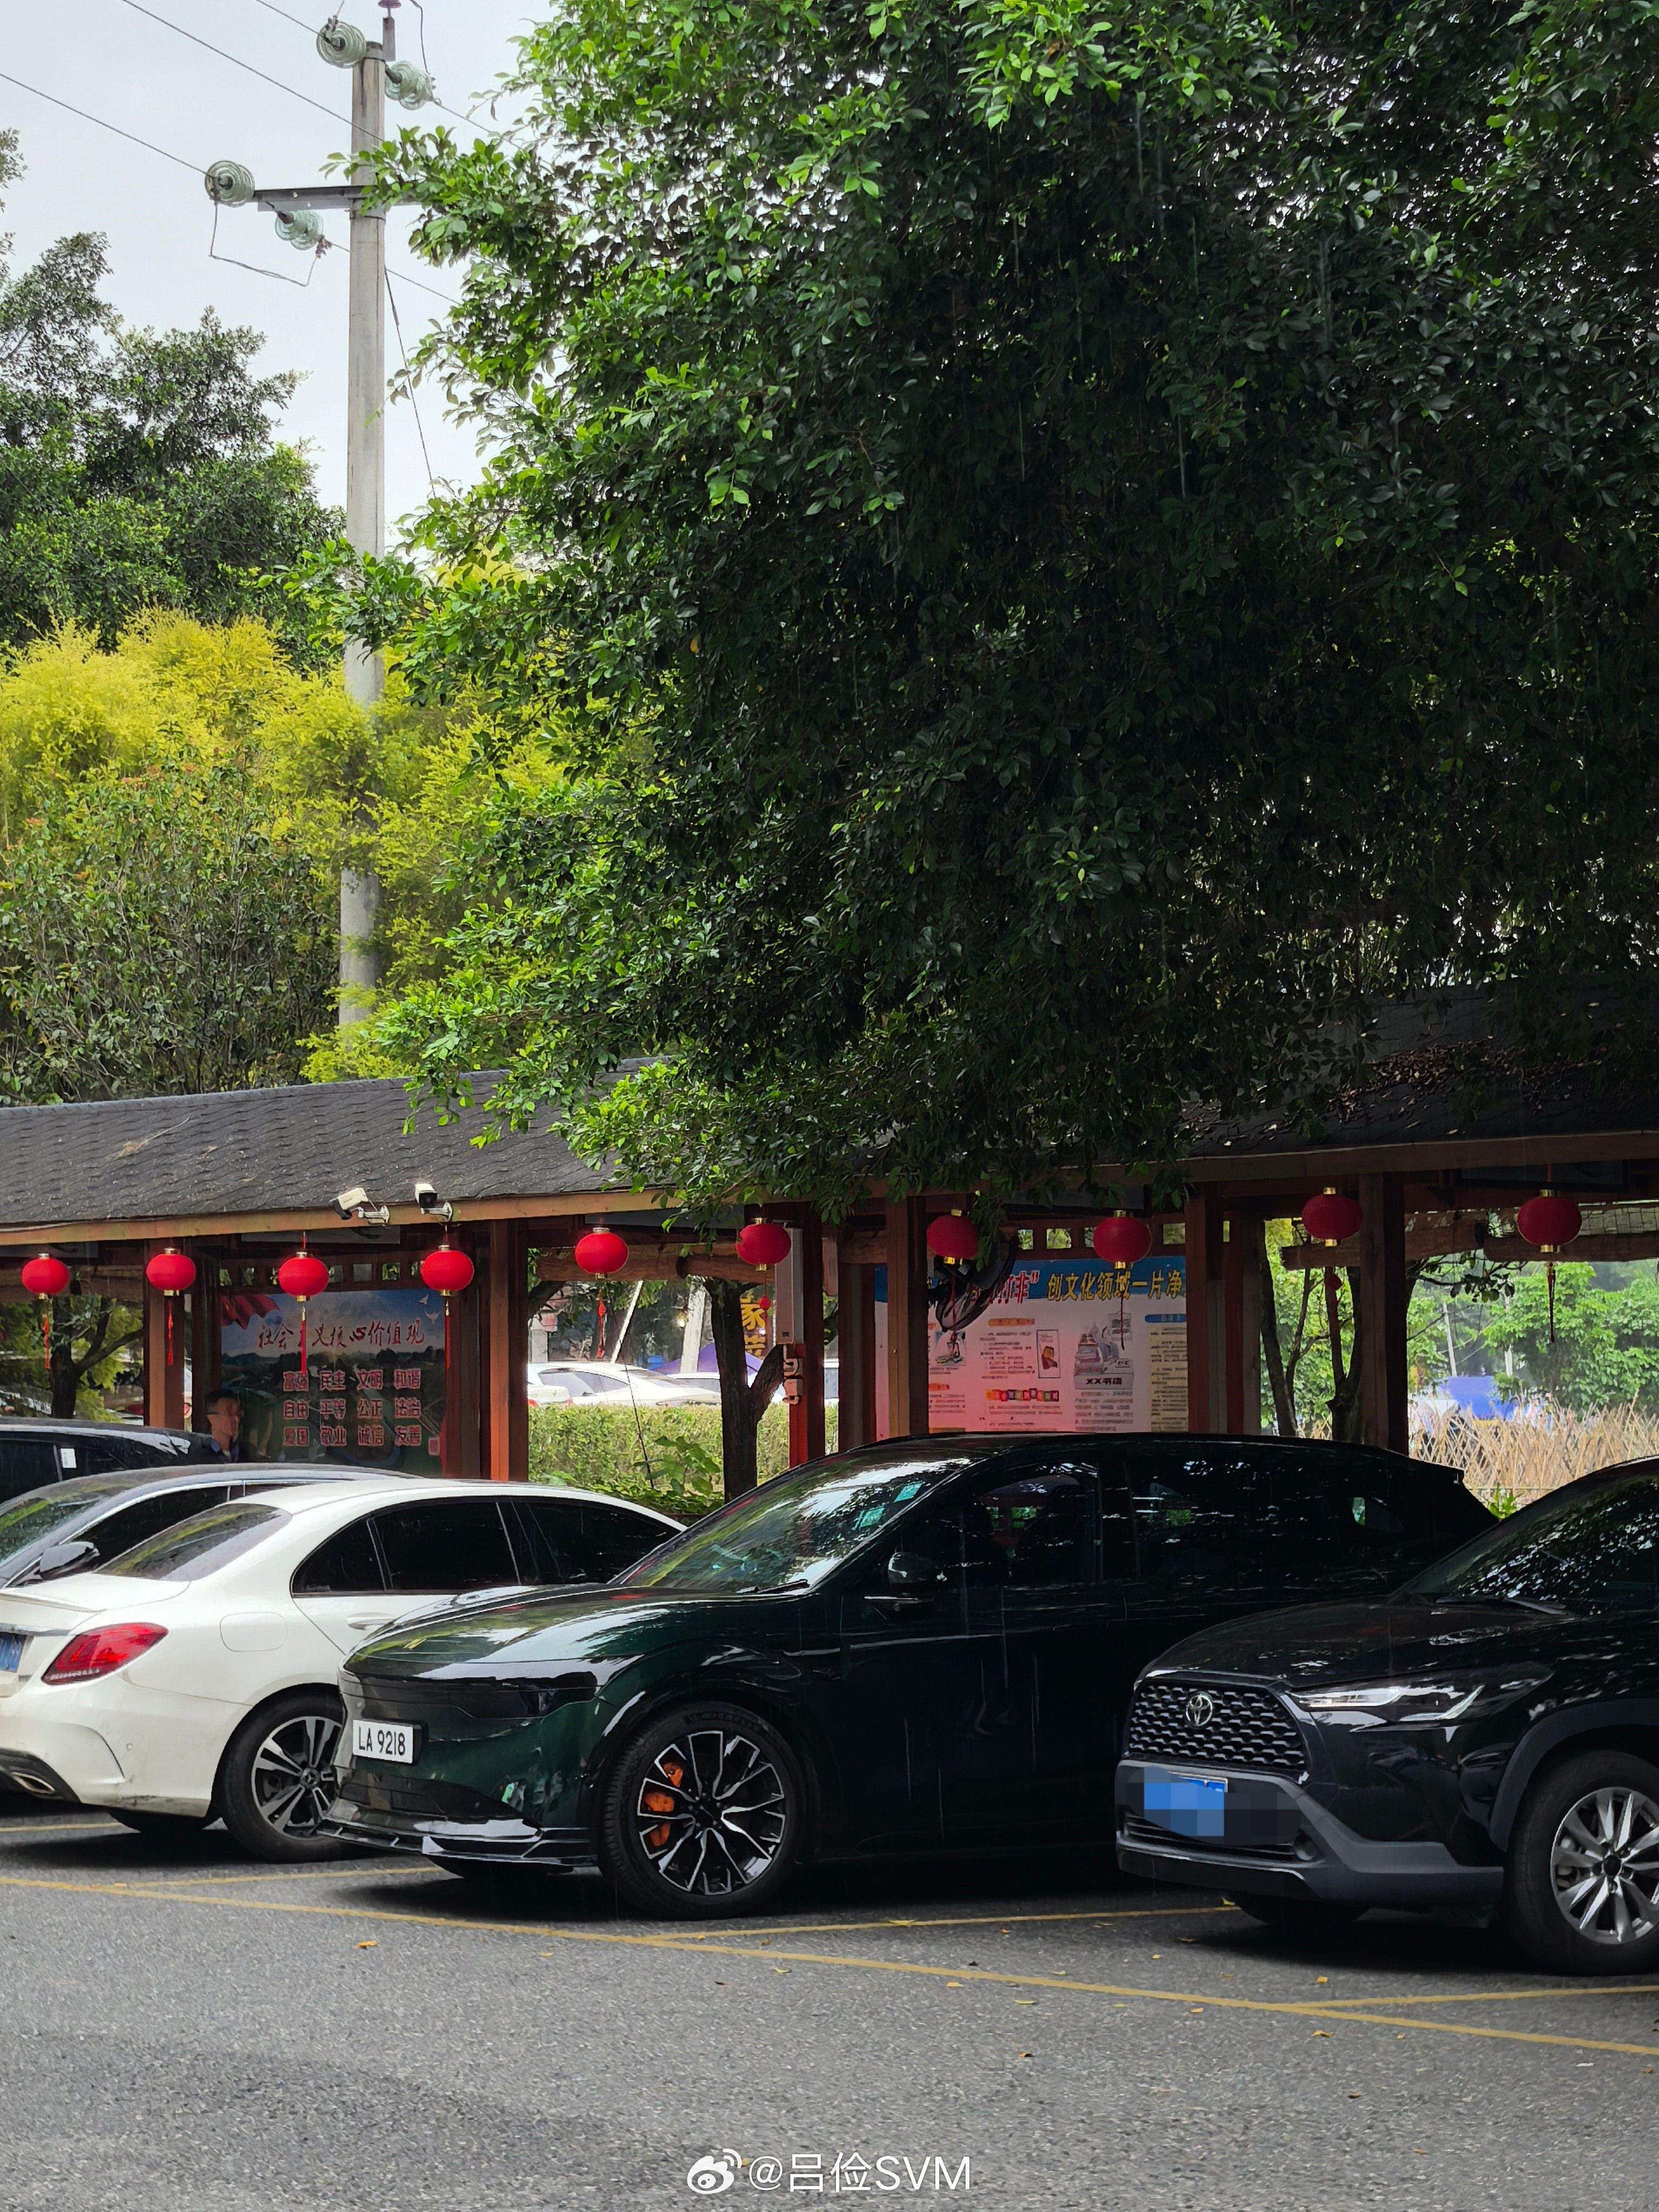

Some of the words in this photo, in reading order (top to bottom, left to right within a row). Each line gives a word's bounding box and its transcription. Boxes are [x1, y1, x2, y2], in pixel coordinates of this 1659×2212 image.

[319, 1370, 346, 1391] 民主
[357, 1368, 383, 1390] 文明
[394, 1368, 421, 1389] 和谐
[284, 1399, 309, 1420] 自由
[320, 1398, 346, 1419] 平等
[357, 1398, 383, 1419] 公正
[394, 1397, 421, 1419] 法治
[320, 1424, 347, 1446] 敬业
[358, 1424, 384, 1446] 诚信
[394, 1424, 422, 1446] 友善
[359, 1725, 373, 1752] LA
[377, 1730, 405, 1756] 9218
